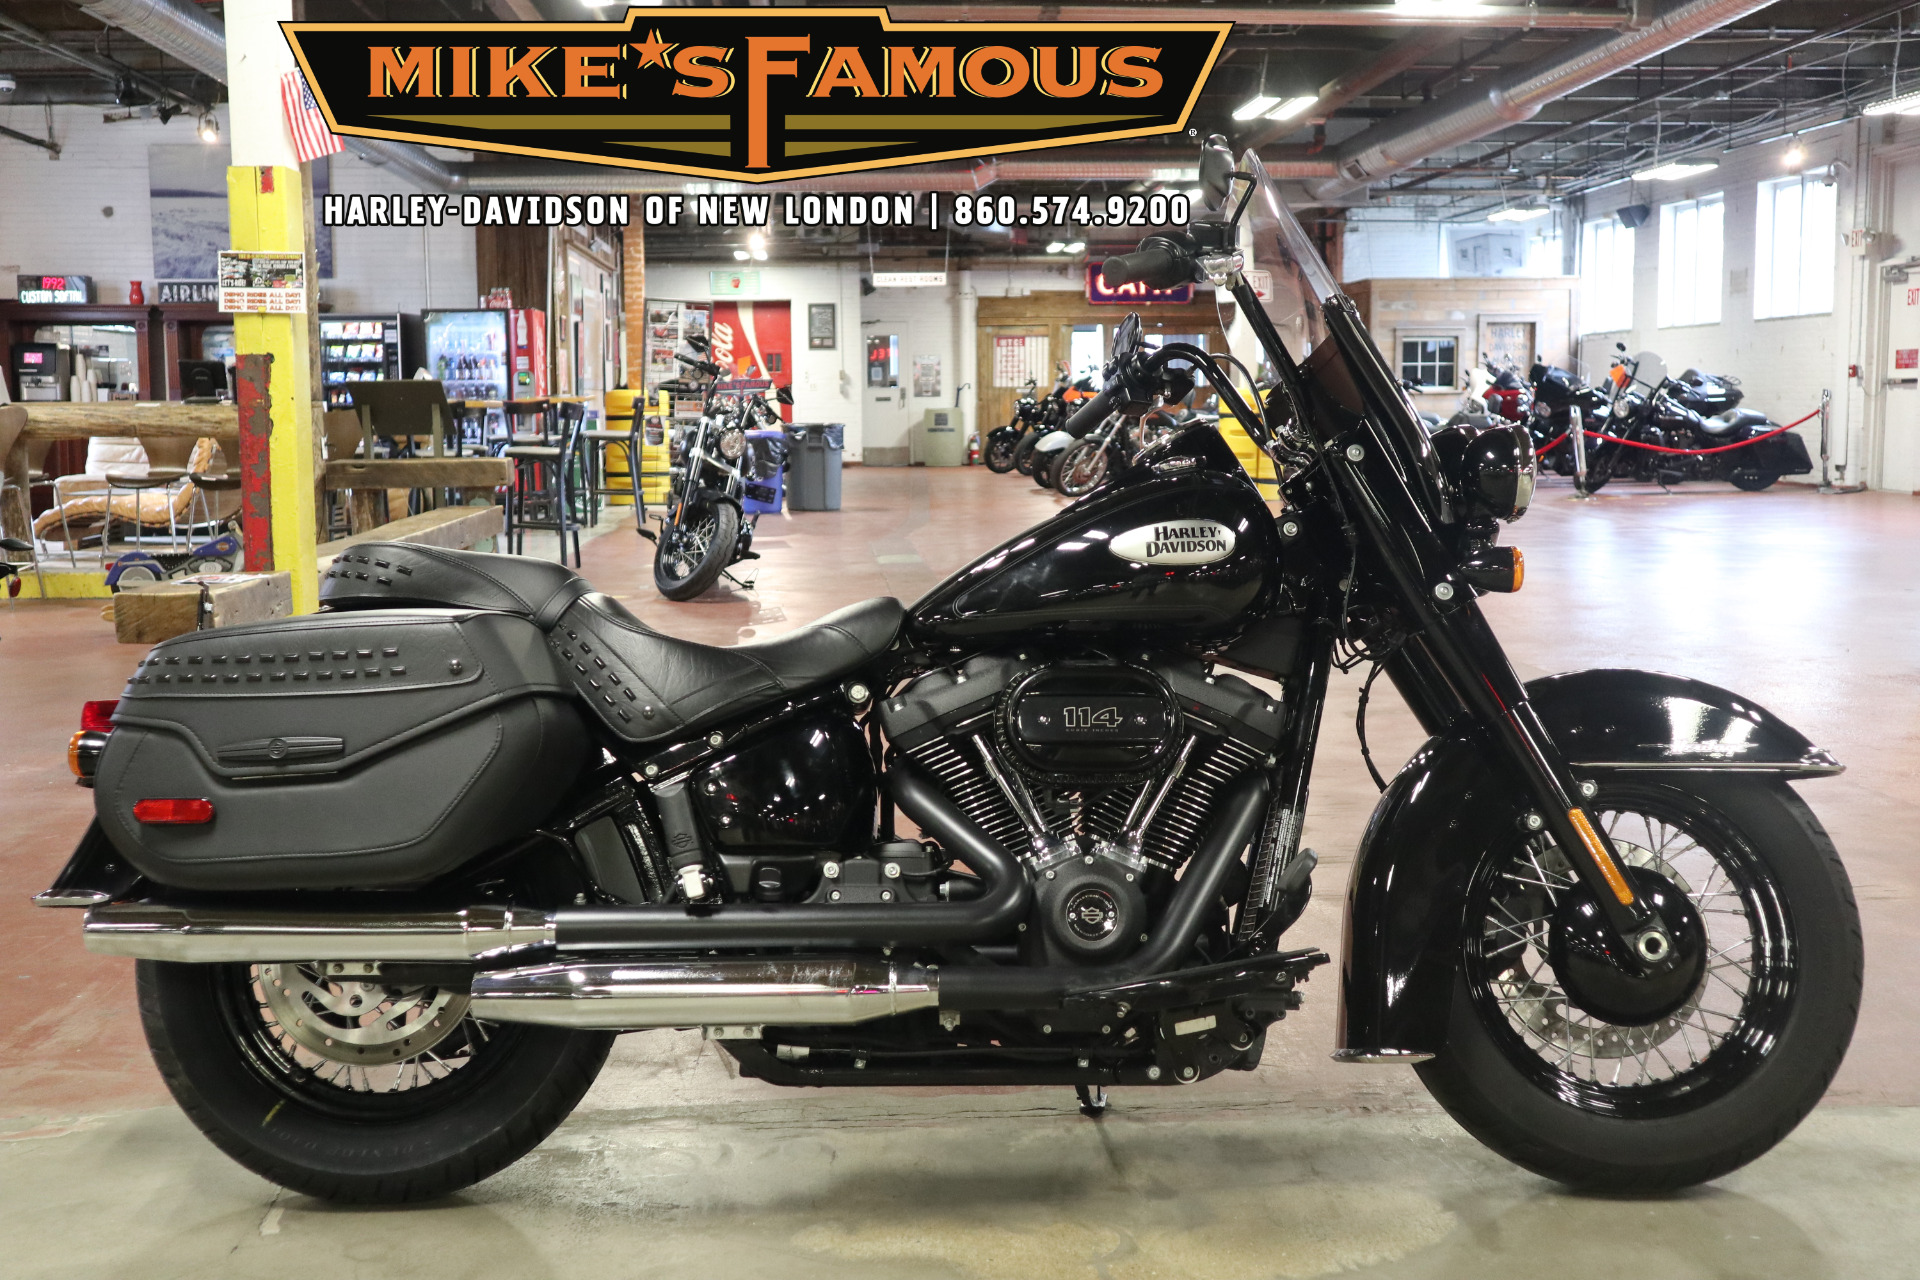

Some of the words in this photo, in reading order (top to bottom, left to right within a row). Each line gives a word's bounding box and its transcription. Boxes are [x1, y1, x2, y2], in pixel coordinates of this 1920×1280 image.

[1852, 230, 1863, 248] EXIT
[42, 276, 65, 290] 1992
[1253, 275, 1269, 289] EXIT
[21, 290, 53, 304] CUSTOM
[1907, 288, 1920, 306] EXIT
[1146, 540, 1227, 557] DAVIDSON
[1063, 706, 1123, 727] 114
